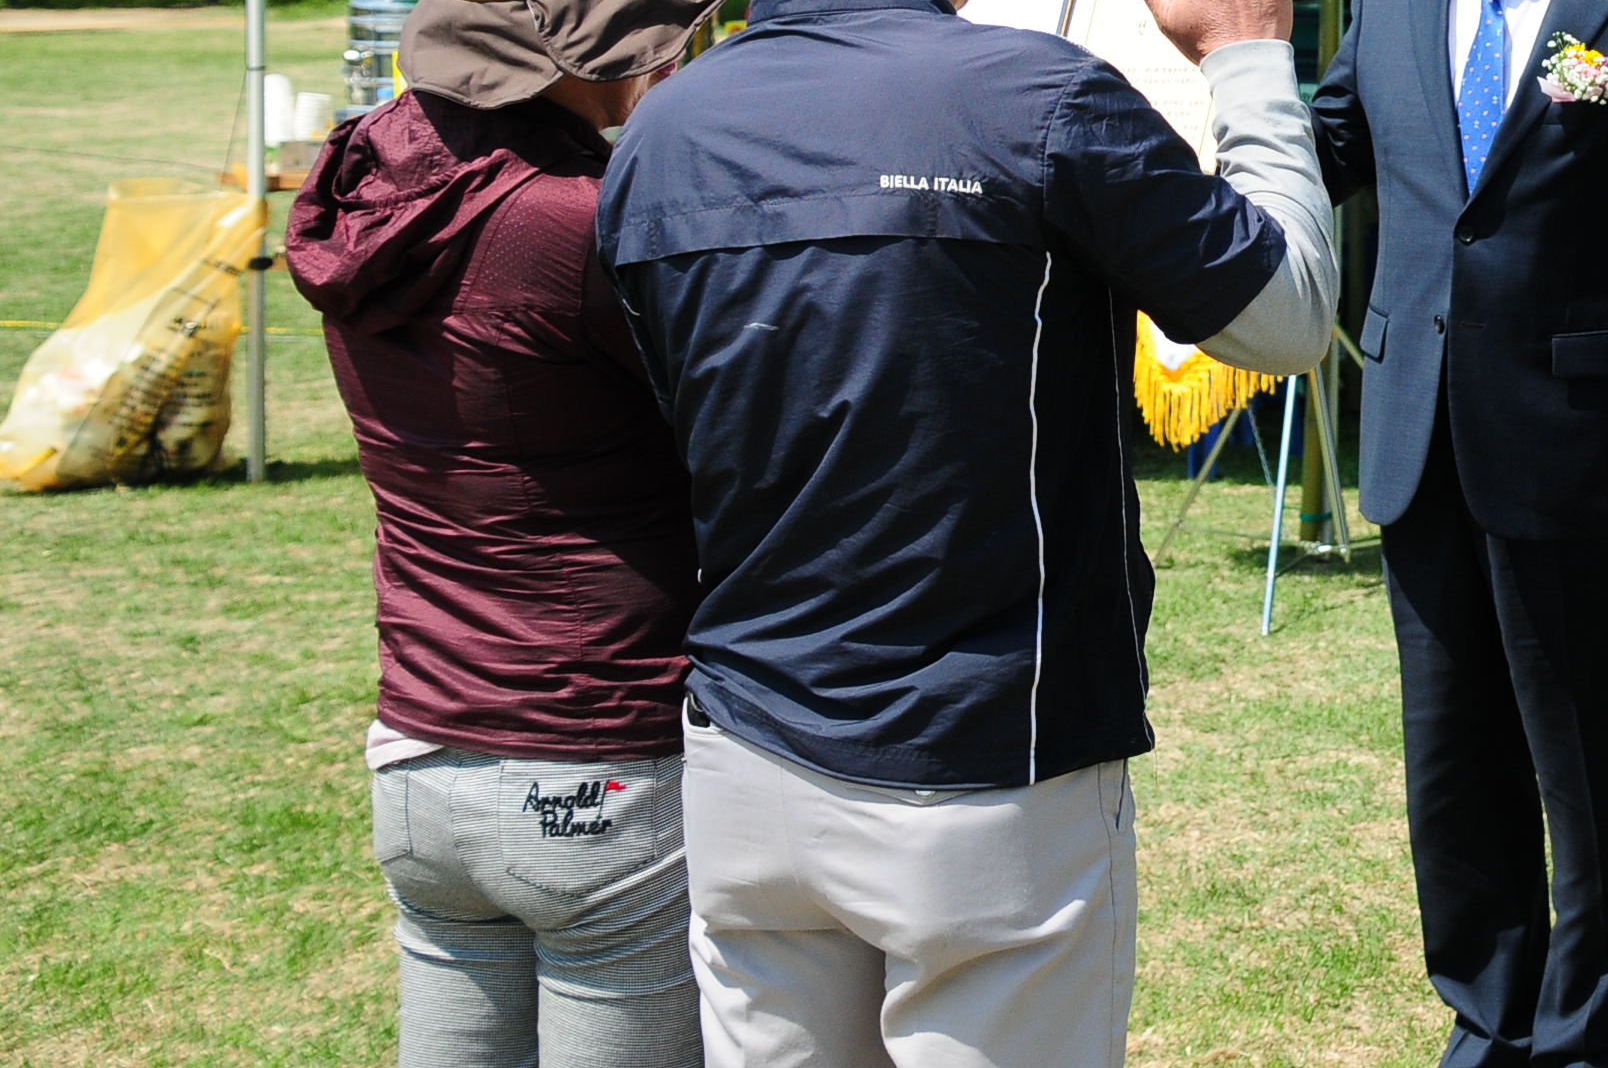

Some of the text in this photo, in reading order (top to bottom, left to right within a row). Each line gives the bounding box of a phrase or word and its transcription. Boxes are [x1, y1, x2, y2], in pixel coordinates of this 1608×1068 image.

[880, 174, 983, 194] BIELLA ITALIA
[522, 780, 602, 812] Arnold
[540, 809, 613, 838] Palmer
